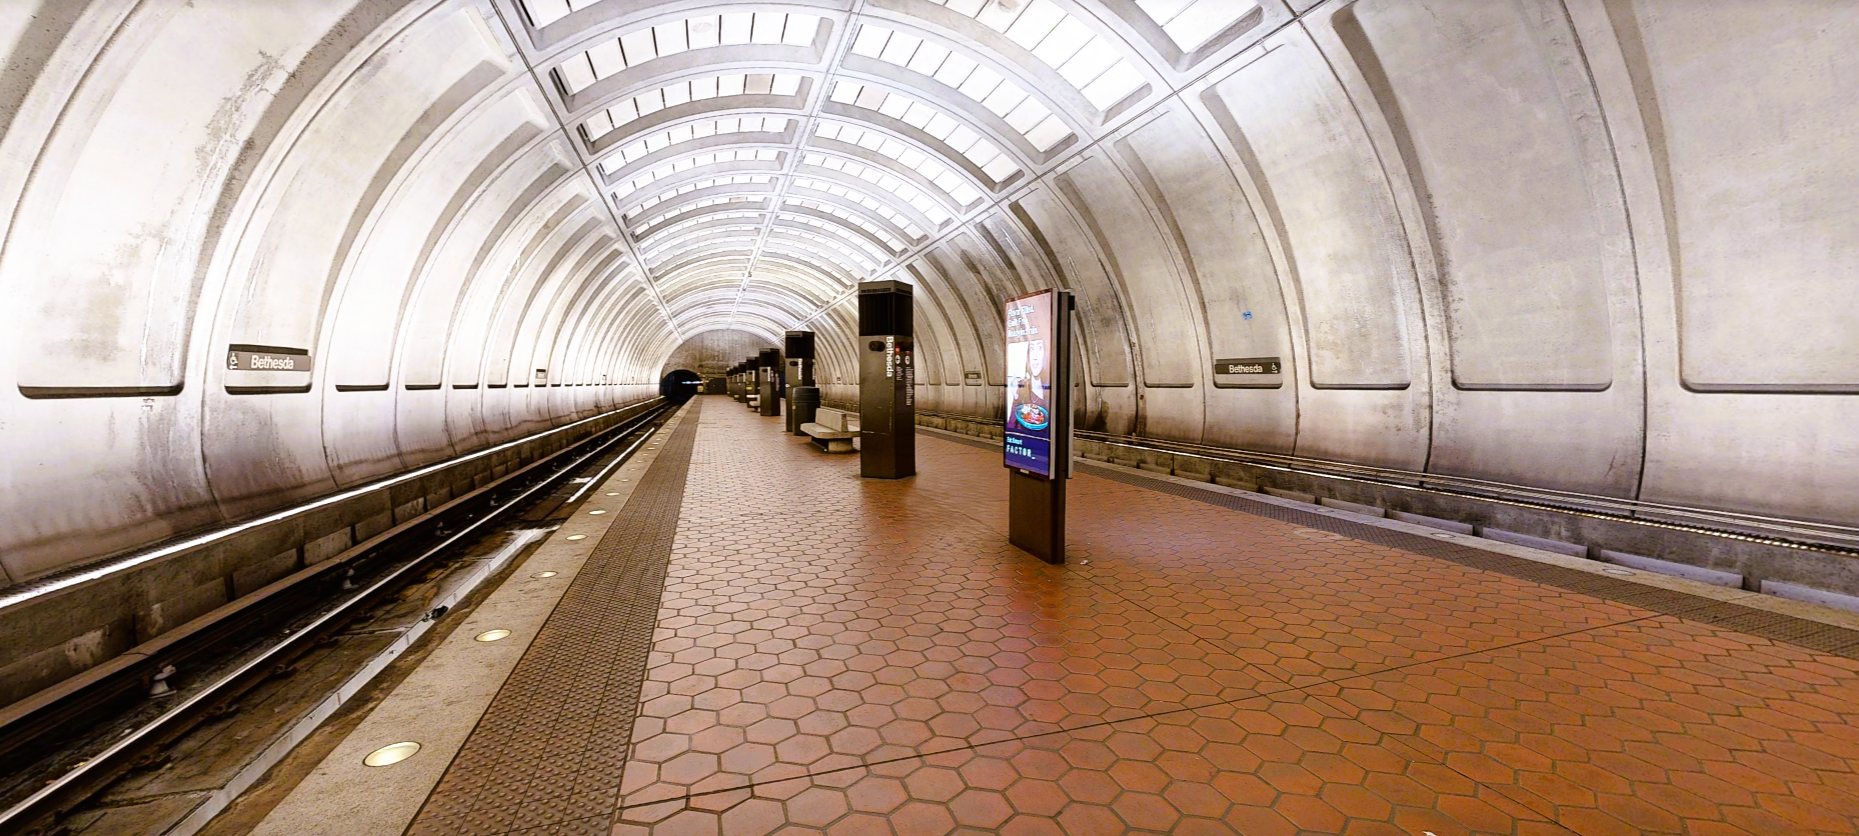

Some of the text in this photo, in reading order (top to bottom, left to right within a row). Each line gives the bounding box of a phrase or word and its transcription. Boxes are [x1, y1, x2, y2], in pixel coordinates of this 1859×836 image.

[251, 355, 294, 369] Bethesda
[886, 336, 894, 377] Bethesda
[1228, 364, 1263, 373] Bethesda
